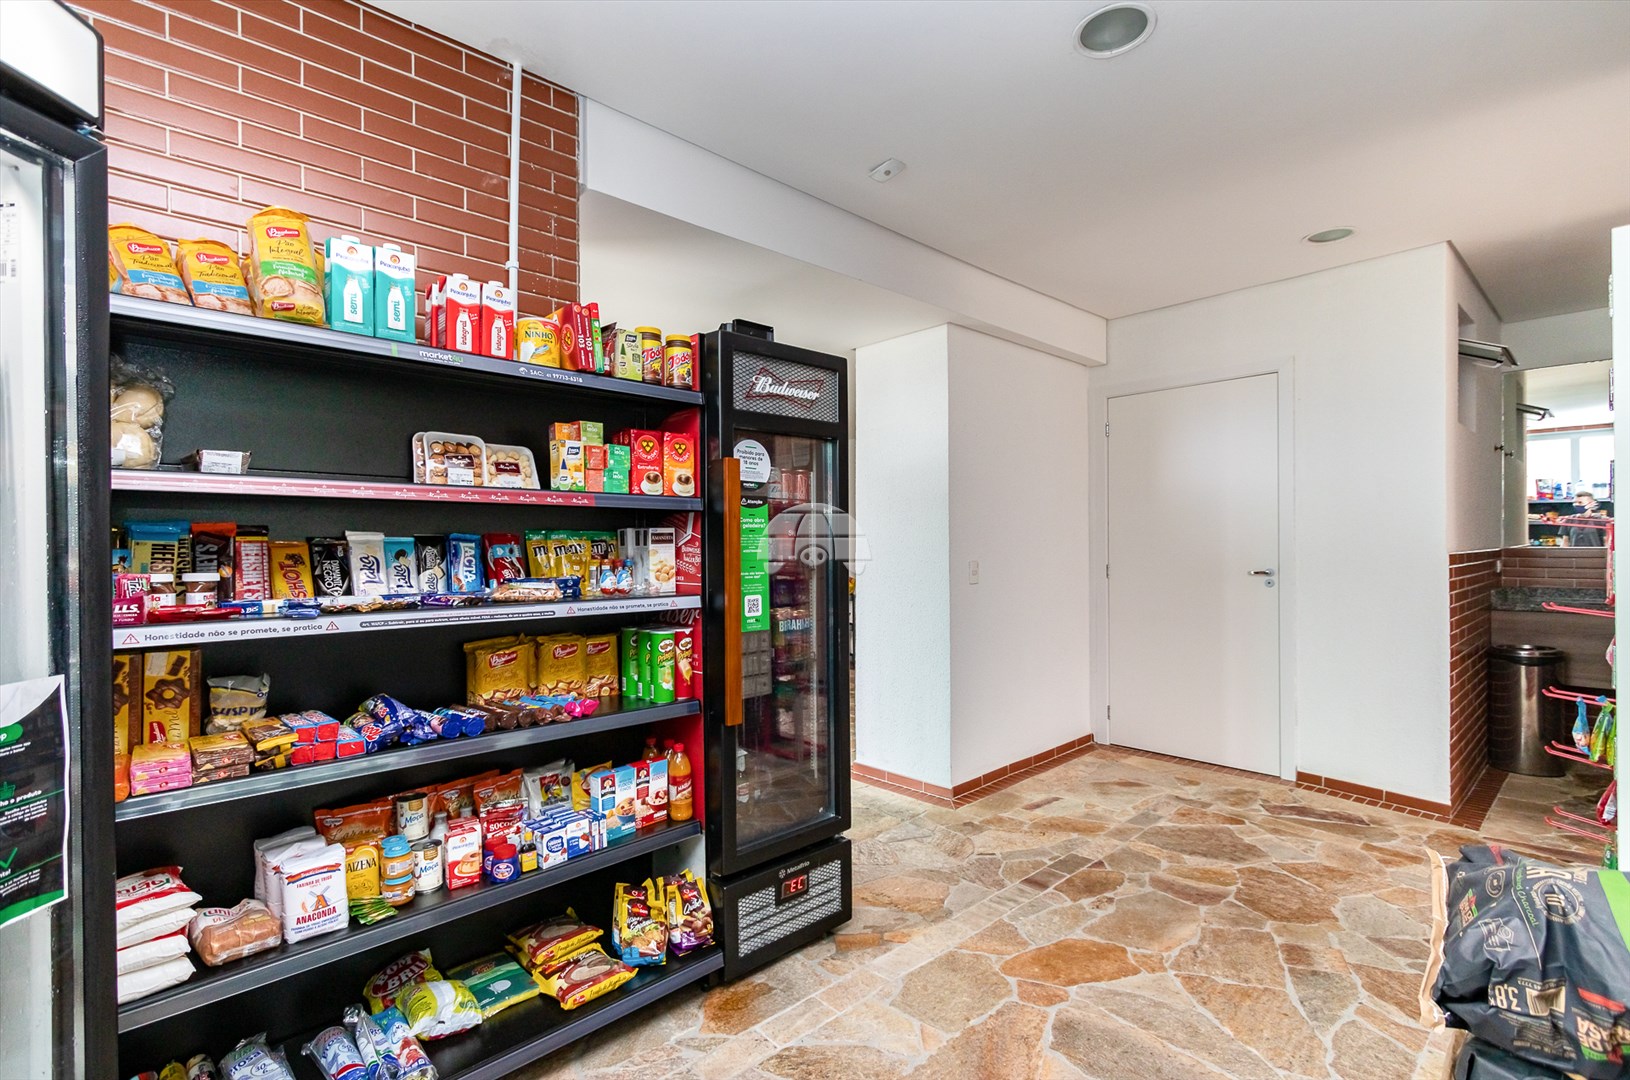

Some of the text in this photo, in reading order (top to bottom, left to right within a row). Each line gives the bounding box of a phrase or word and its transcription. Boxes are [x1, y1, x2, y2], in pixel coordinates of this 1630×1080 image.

[460, 320, 470, 346] integral
[494, 326, 504, 351] integral
[524, 330, 553, 340] NINHO
[752, 375, 820, 400] Budweiser
[322, 560, 334, 589] NEGRO
[458, 542, 476, 583] LACTA
[144, 631, 205, 642] Honestidade
[240, 627, 280, 639] promete,
[294, 624, 322, 632] pratica
[490, 652, 517, 667] Bauducco
[404, 813, 424, 824] Moça
[420, 862, 439, 873] Moça
[786, 860, 810, 874] Metalfrio
[296, 906, 337, 926] ANACONDA
[1517, 888, 1540, 928] Charcoal
[374, 956, 412, 984] BOM
[388, 960, 428, 990] BRIL
